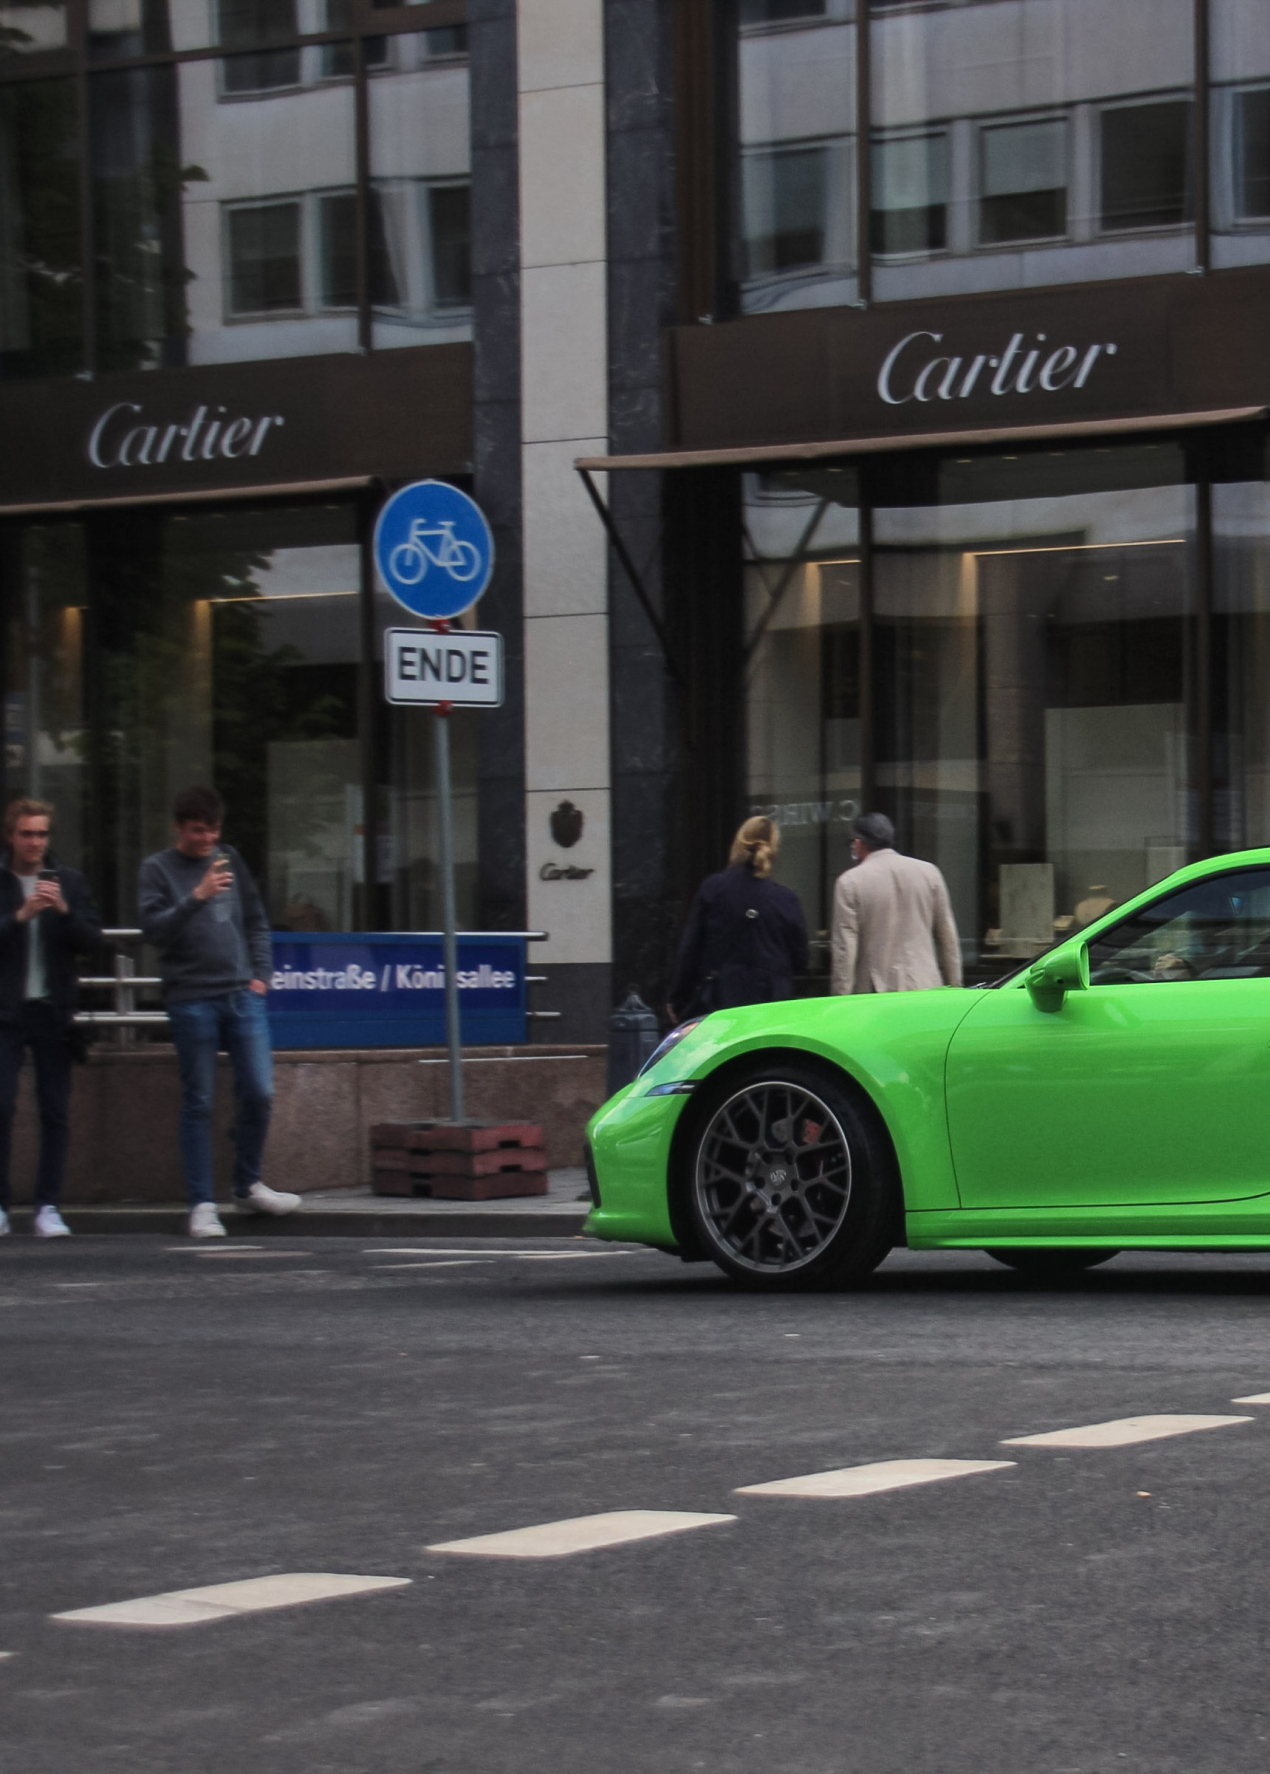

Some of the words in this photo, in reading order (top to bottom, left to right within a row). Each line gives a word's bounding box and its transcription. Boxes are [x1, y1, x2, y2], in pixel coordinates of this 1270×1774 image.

[878, 331, 1117, 404] Cartier
[86, 402, 285, 469] Cartier
[398, 646, 490, 685] ENDE
[270, 963, 376, 989] einstraße
[396, 963, 516, 989] Könisallee
